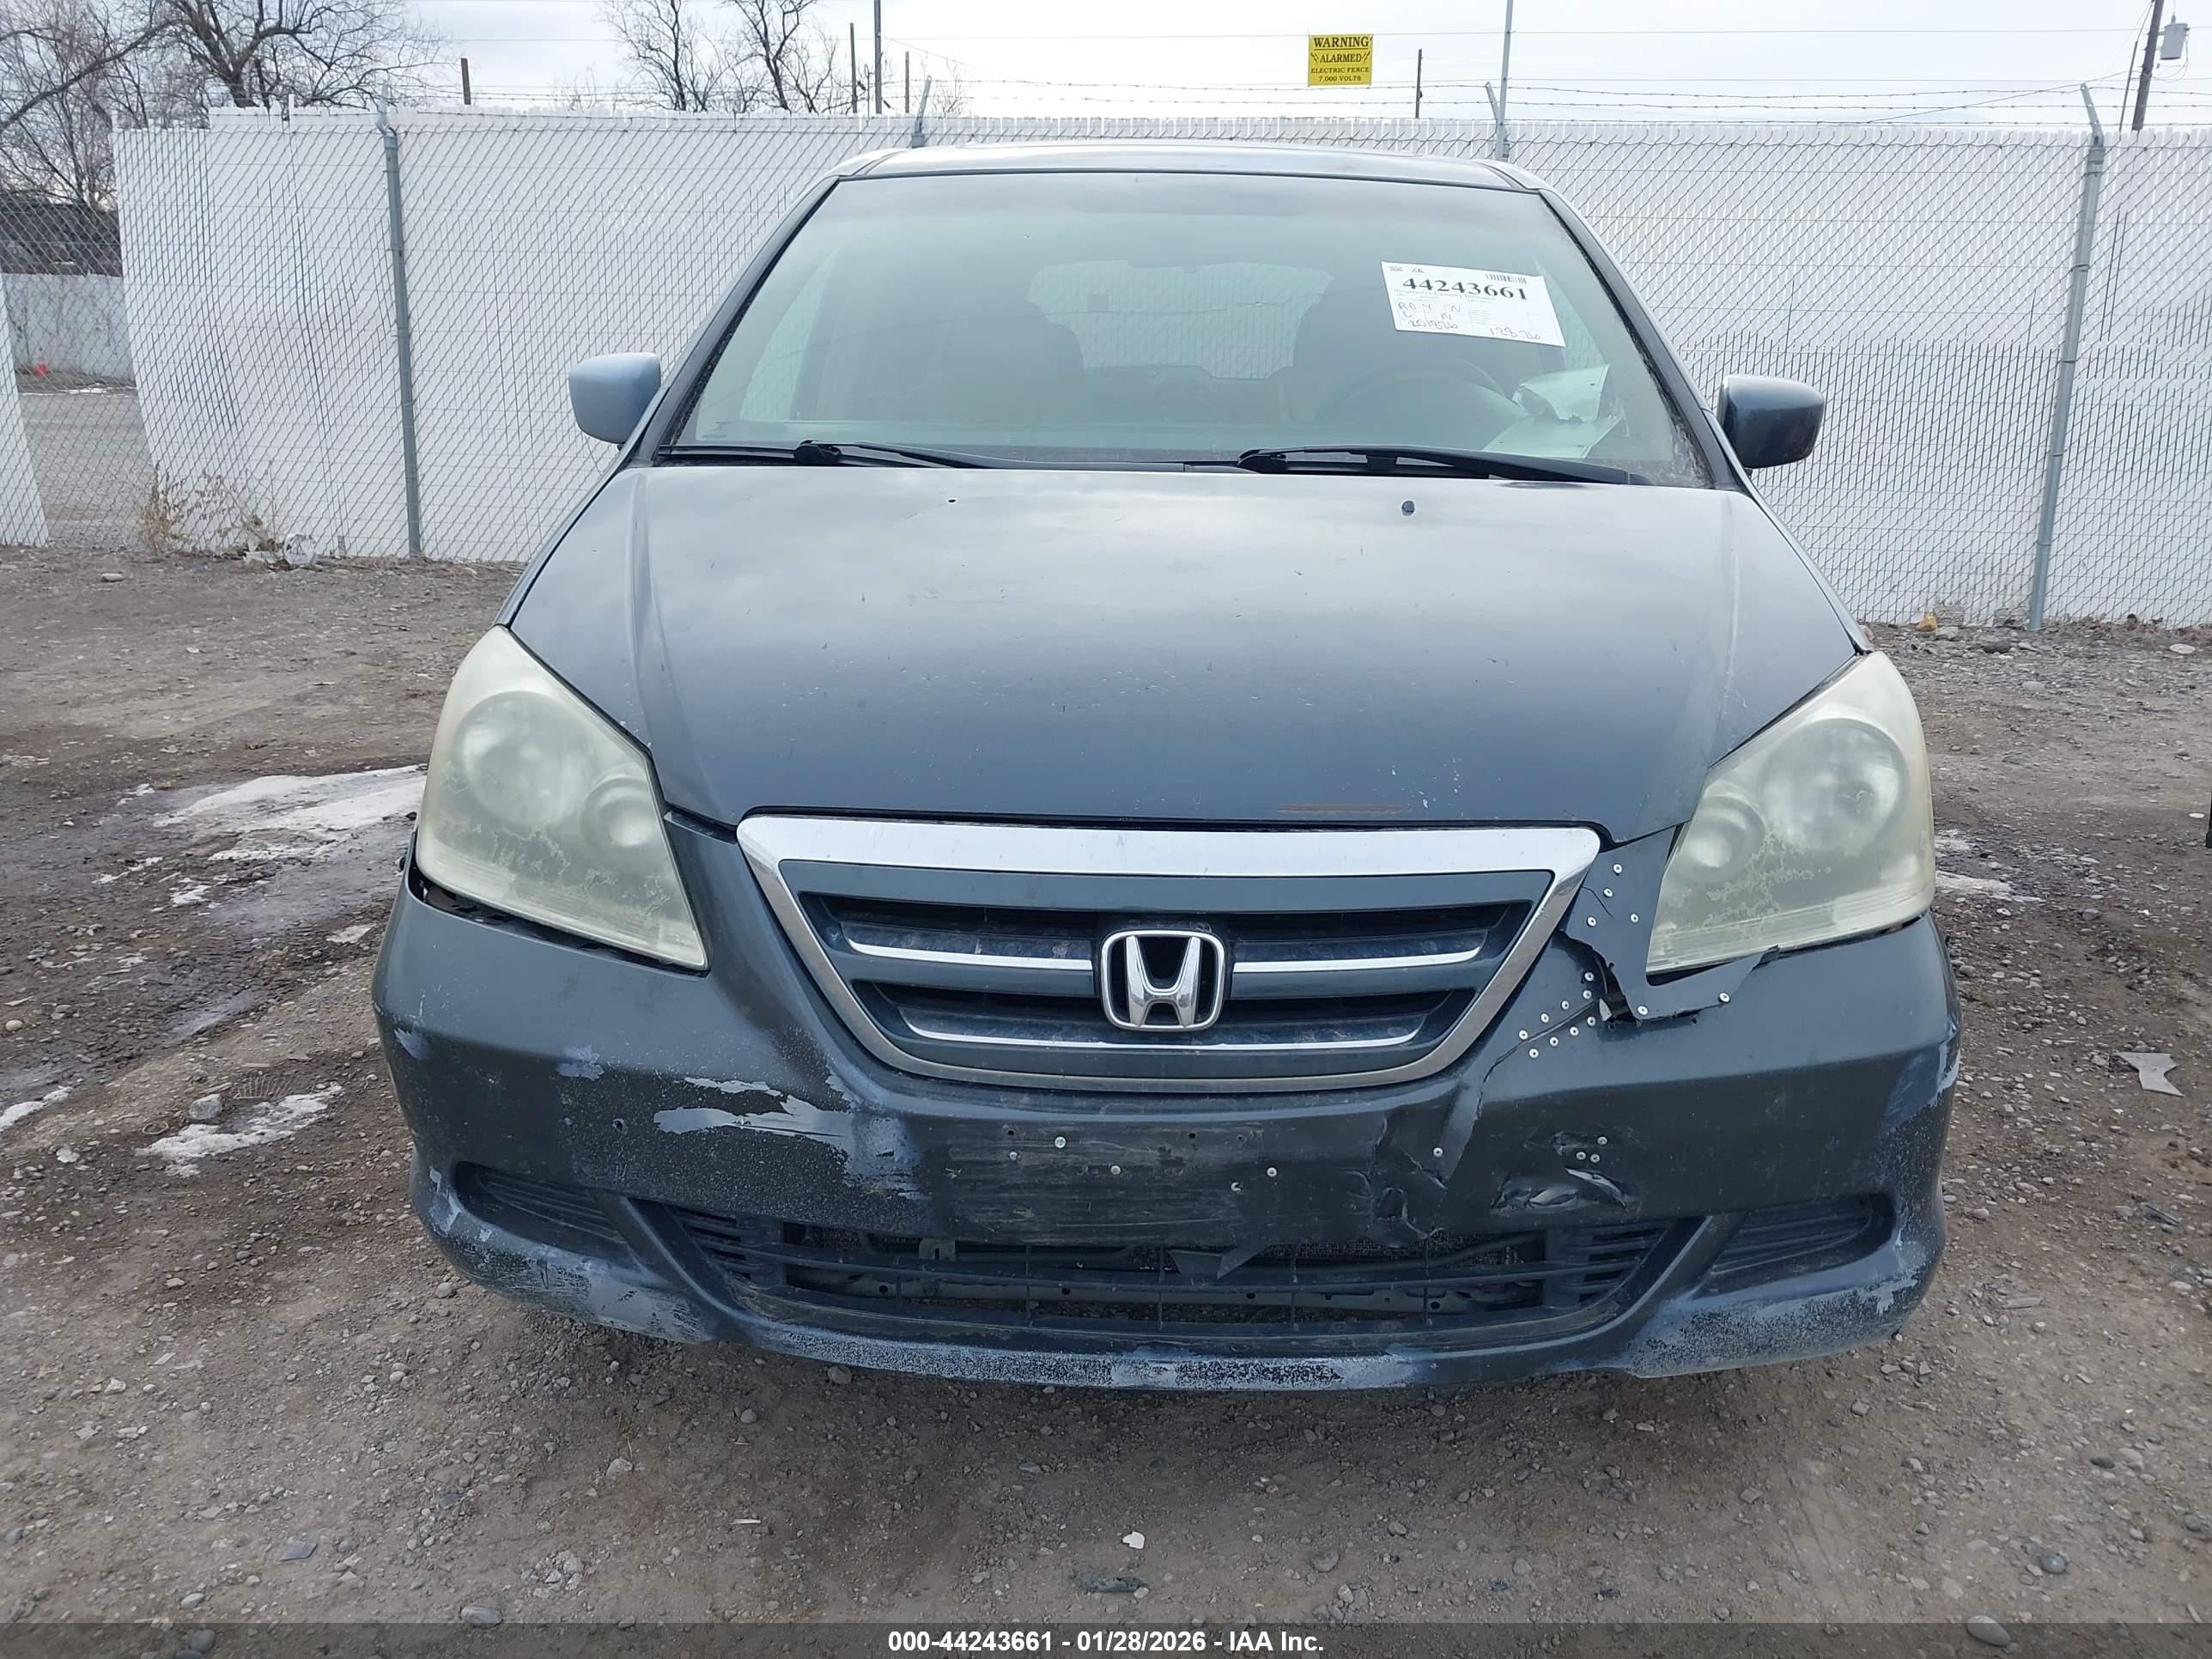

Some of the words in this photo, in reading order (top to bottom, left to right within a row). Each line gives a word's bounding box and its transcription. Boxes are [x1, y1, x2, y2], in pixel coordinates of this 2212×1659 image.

[1313, 36, 1370, 48] WARNING
[1320, 53, 1362, 64] ALARMED
[1402, 277, 1527, 301] 44243661
